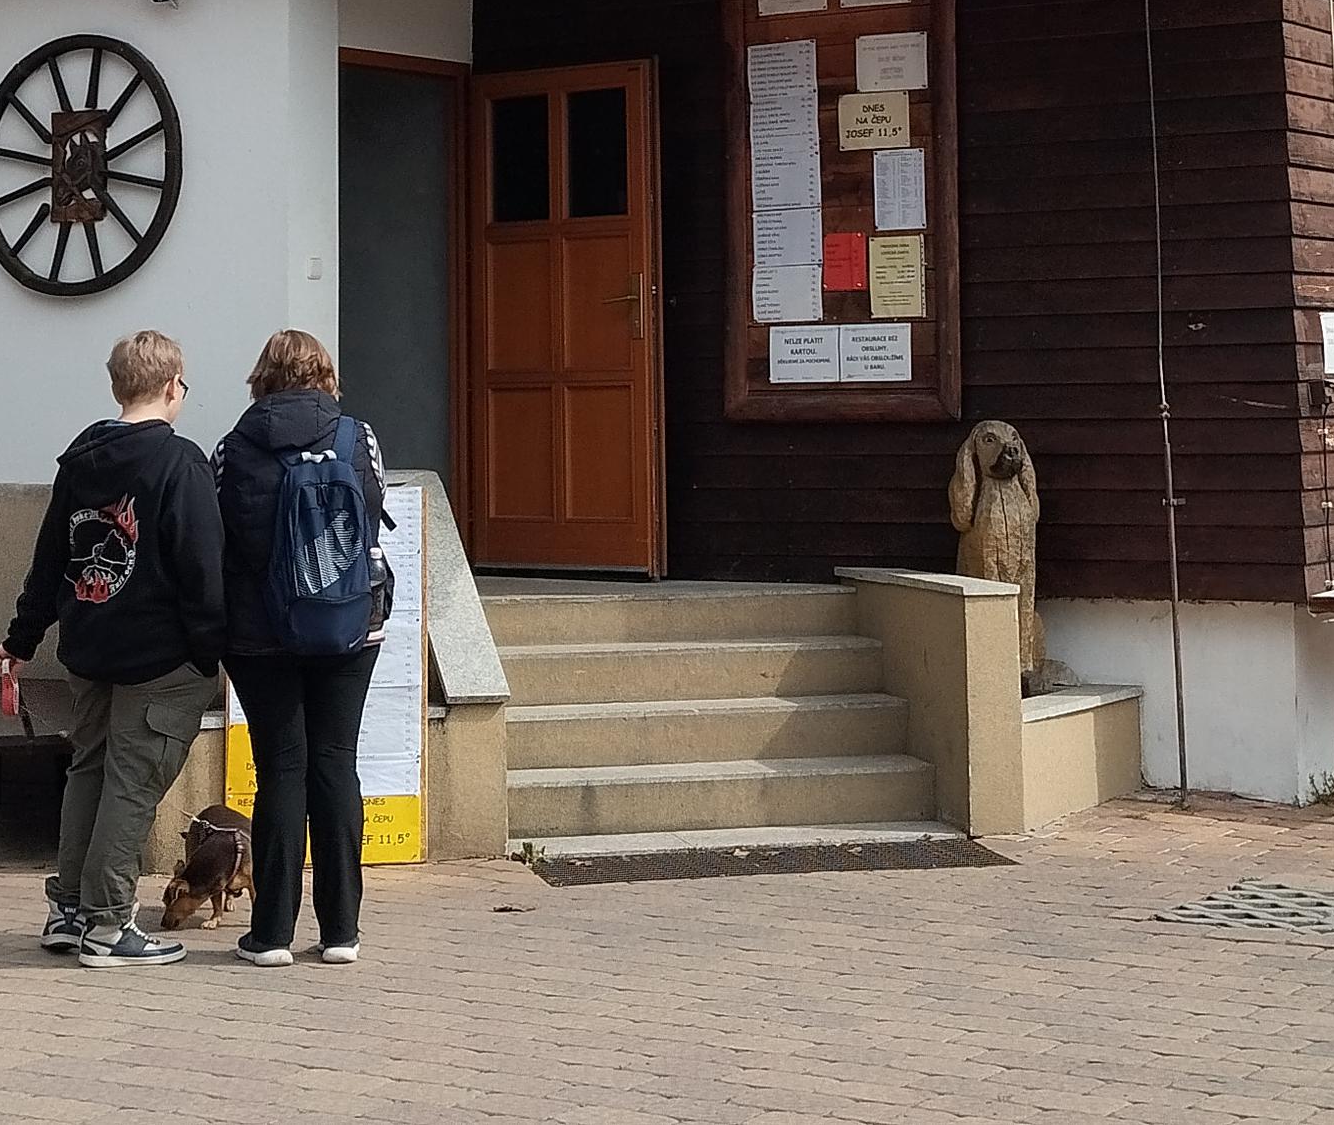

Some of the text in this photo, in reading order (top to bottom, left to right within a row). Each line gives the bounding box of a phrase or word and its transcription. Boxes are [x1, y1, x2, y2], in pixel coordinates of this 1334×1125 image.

[862, 104, 885, 113] DNES
[855, 114, 892, 125] NA ČEPU
[846, 126, 902, 139] JOSEF 11,5°
[372, 813, 394, 823] ČEPU
[378, 832, 411, 846] 11,5°
